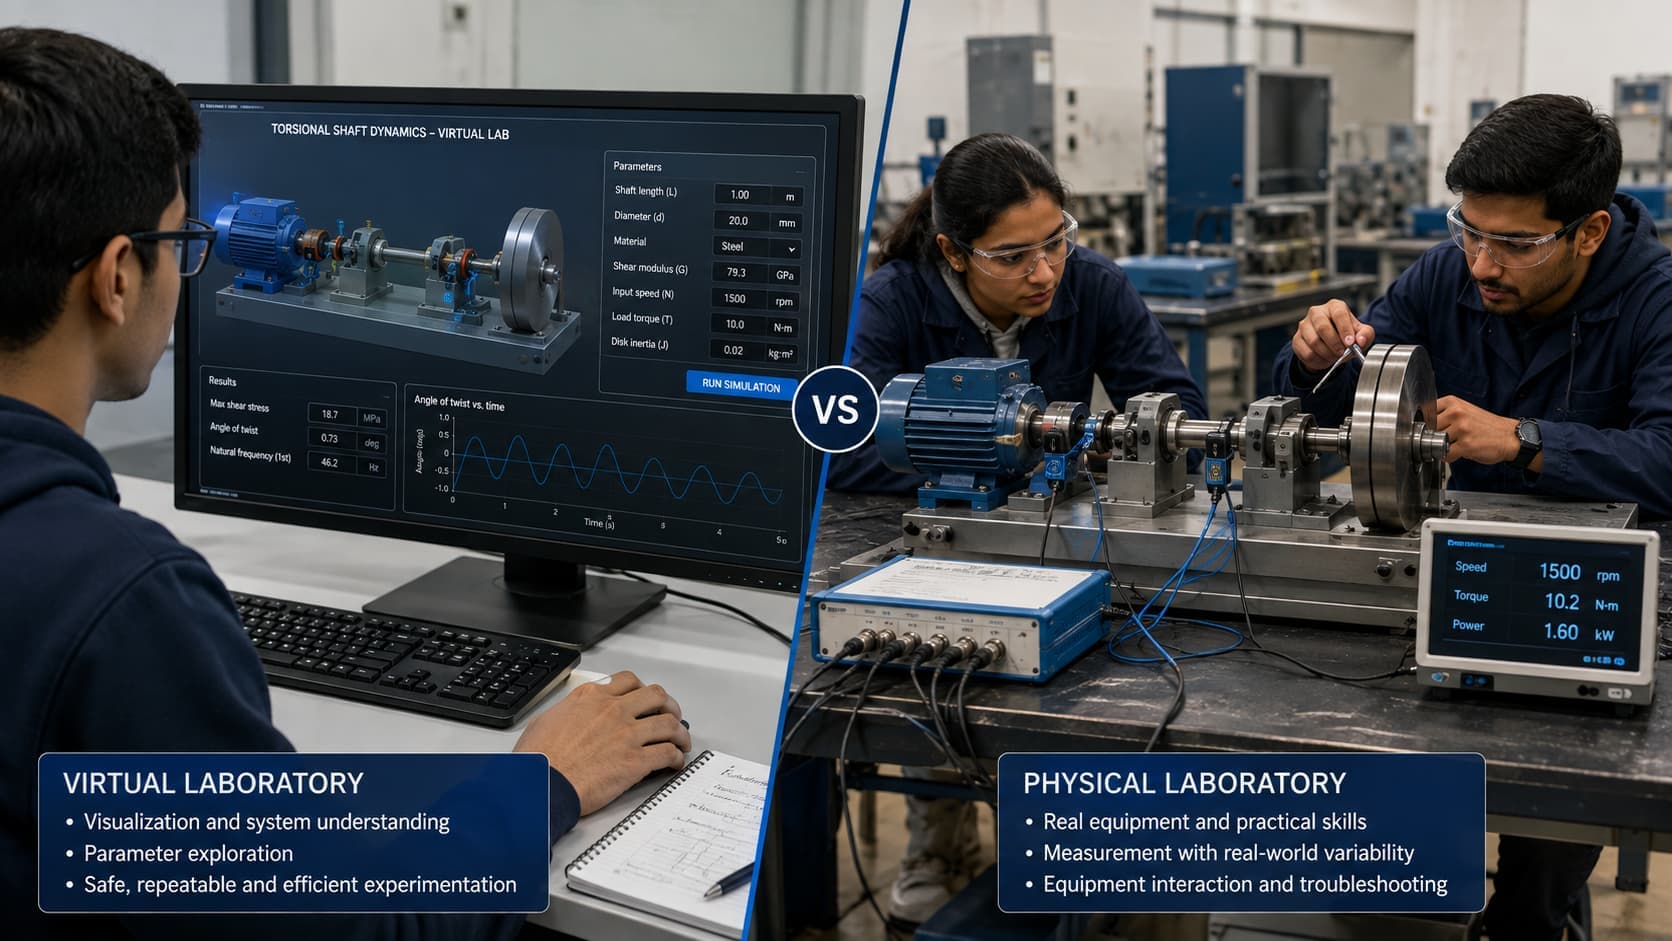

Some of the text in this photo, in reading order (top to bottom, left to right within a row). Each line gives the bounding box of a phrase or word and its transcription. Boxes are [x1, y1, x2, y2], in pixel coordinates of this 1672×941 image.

[272, 123, 330, 135] TORSIONAL
[333, 125, 367, 136] SHAFT
[371, 126, 426, 137] DYNAMICS
[438, 128, 484, 139] VIRTUAL
[488, 129, 509, 139] LAB
[614, 161, 661, 171] Parameters
[616, 185, 677, 197] Shaft length (L)
[731, 190, 749, 199] 1.00
[615, 211, 664, 223] Diameter (d)
[729, 216, 748, 225] 20.0
[614, 236, 646, 246] Material
[722, 241, 743, 251] Steel
[614, 261, 688, 275] Shear modulus (G)
[728, 268, 793, 280] 79.3 GPa
[613, 287, 674, 300] Input speed (N)
[725, 294, 793, 307] 1500 rpm
[612, 312, 673, 325] Load torque (T)
[727, 320, 744, 329] 10.0
[612, 337, 668, 350] Disk inertia (J)
[724, 345, 743, 355] 0.02
[209, 376, 236, 386] Results
[703, 378, 780, 392] RUN SIMULATION
[211, 399, 269, 412] Max shear stress
[415, 395, 437, 406] Angle
[440, 397, 448, 406] of
[450, 398, 470, 408] twist
[486, 401, 504, 411] time
[323, 410, 380, 423] 18.7 MPa
[210, 422, 258, 435] Angle of twist
[321, 433, 379, 449] 0.73 deg
[210, 446, 291, 463] Natural frequency (1st)
[321, 458, 379, 472] 46.2 Hz
[435, 484, 448, 492] -1.0
[584, 518, 603, 527] Time
[1456, 561, 1619, 583] Speed 1500 rpm
[1454, 590, 1488, 603] Torque
[1546, 593, 1579, 610] 10.2
[1453, 619, 1614, 641] Power 1.60 kW
